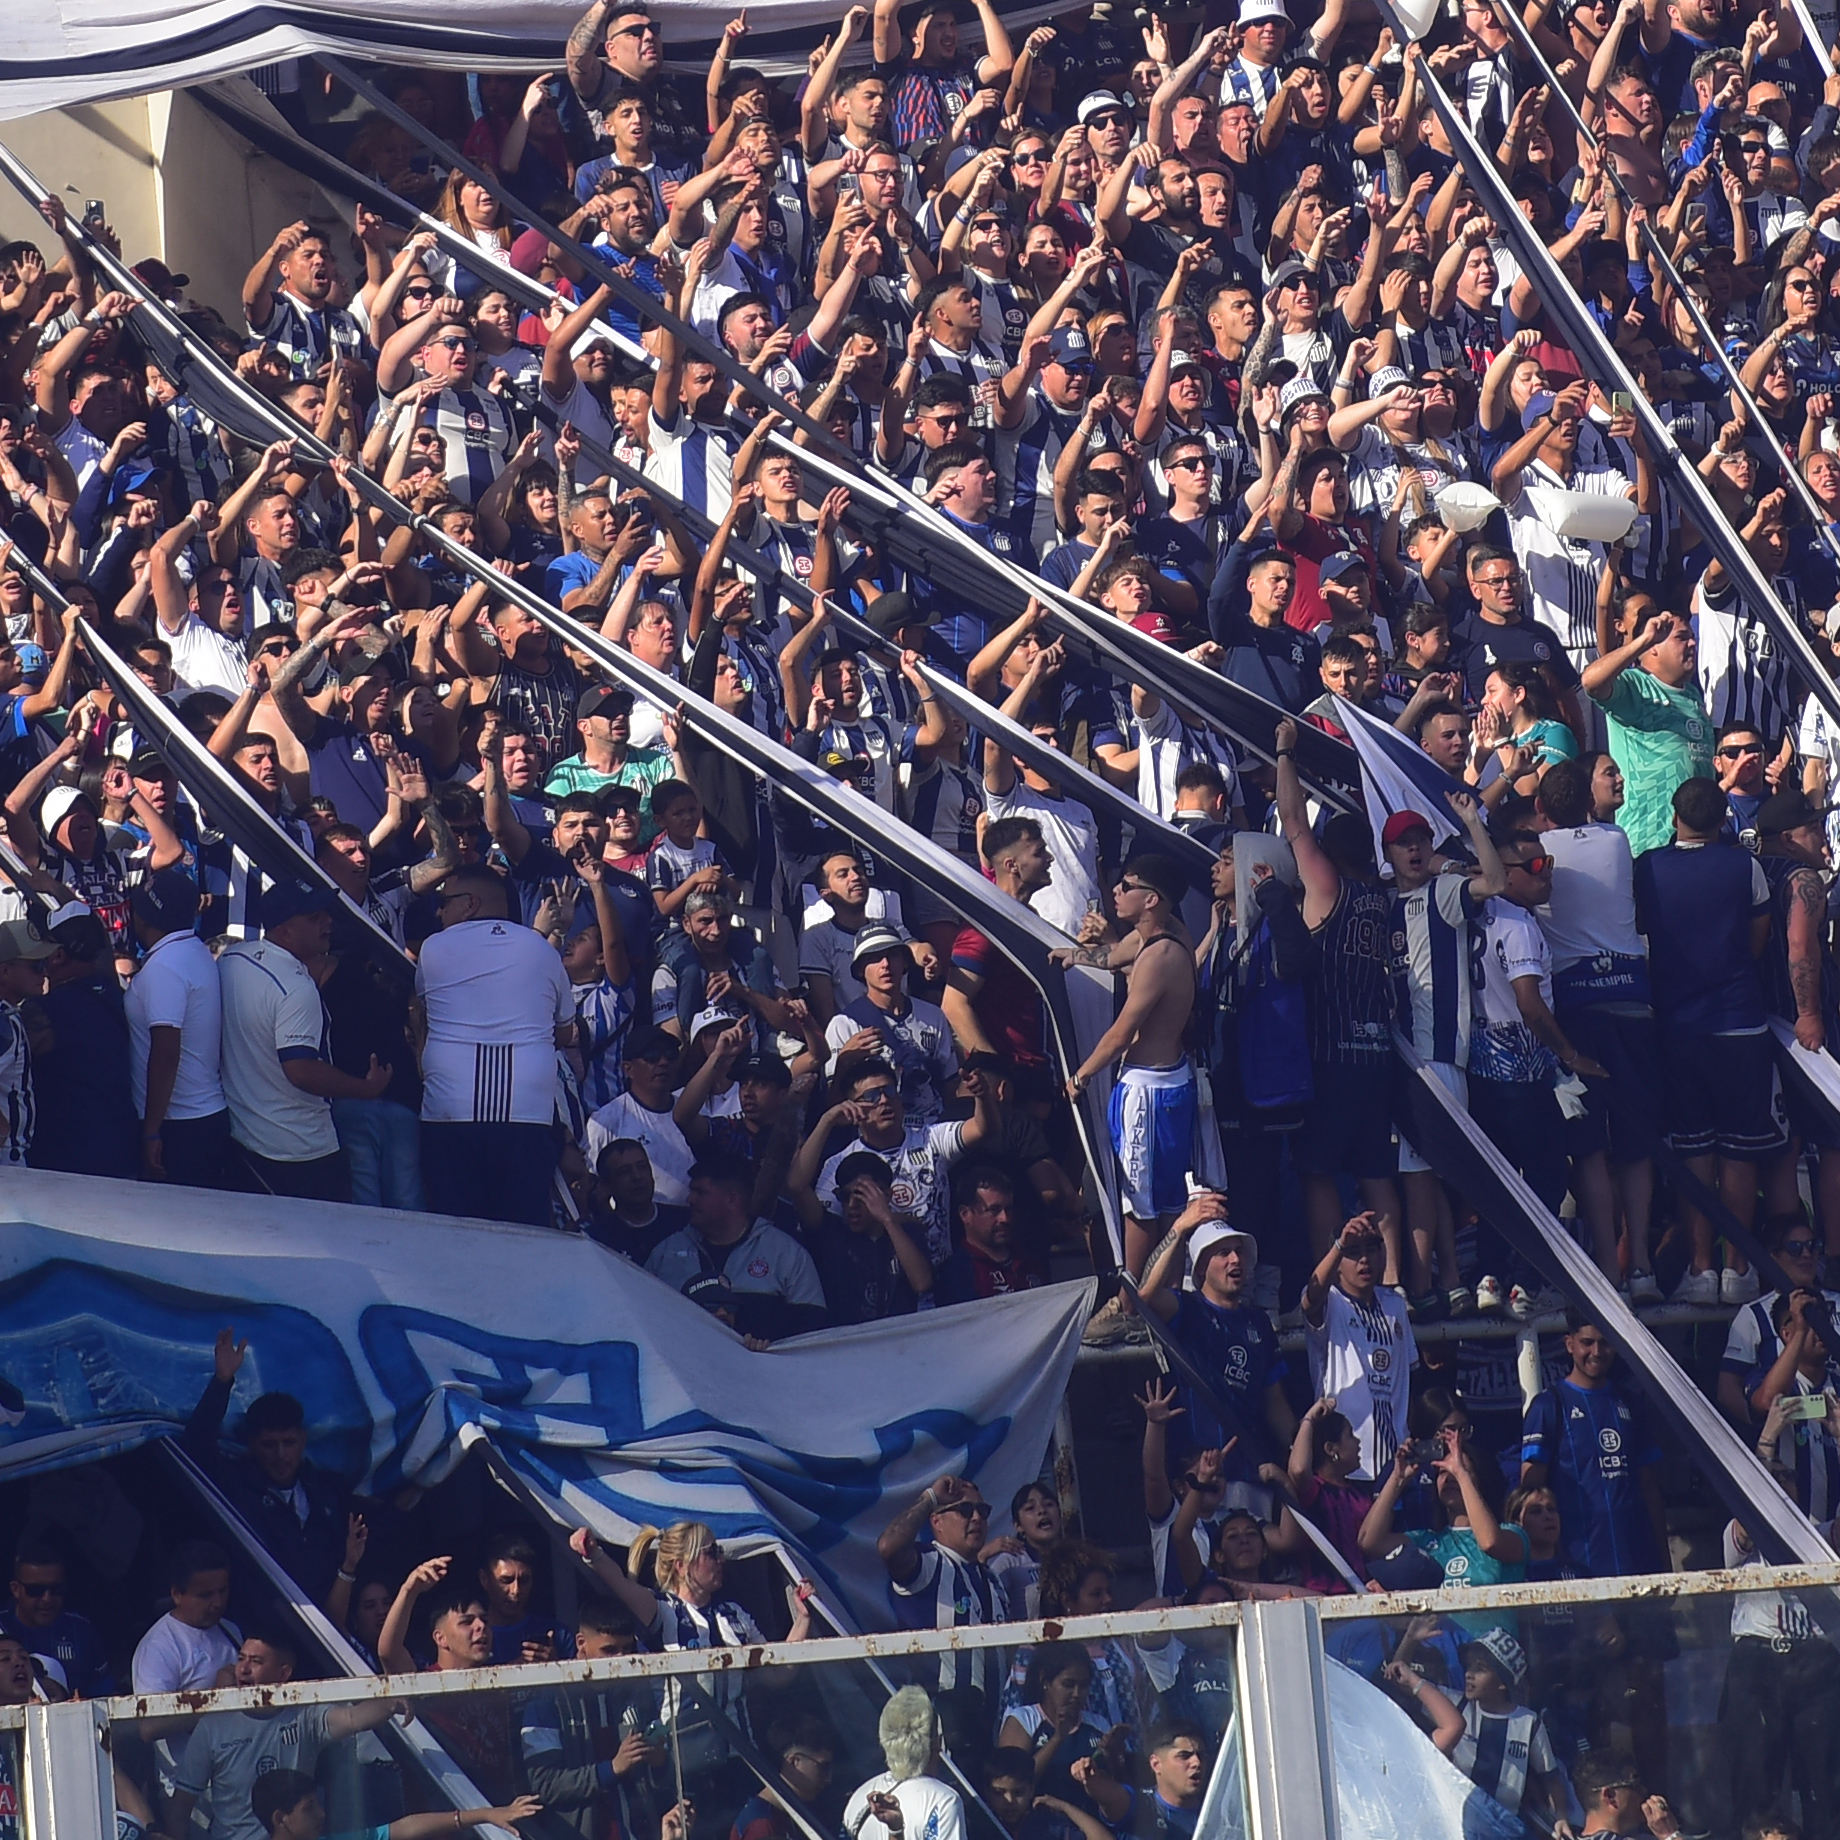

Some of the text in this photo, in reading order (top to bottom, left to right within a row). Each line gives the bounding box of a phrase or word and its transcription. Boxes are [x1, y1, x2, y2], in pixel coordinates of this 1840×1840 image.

[1343, 915, 1389, 956] 191
[1128, 1094, 1147, 1195] LAKERS
[1224, 1365, 1249, 1382] ICBC
[1367, 1372, 1391, 1387] ICBC
[1598, 1454, 1628, 1467] ICBC
[1542, 1604, 1572, 1615] ICBC
